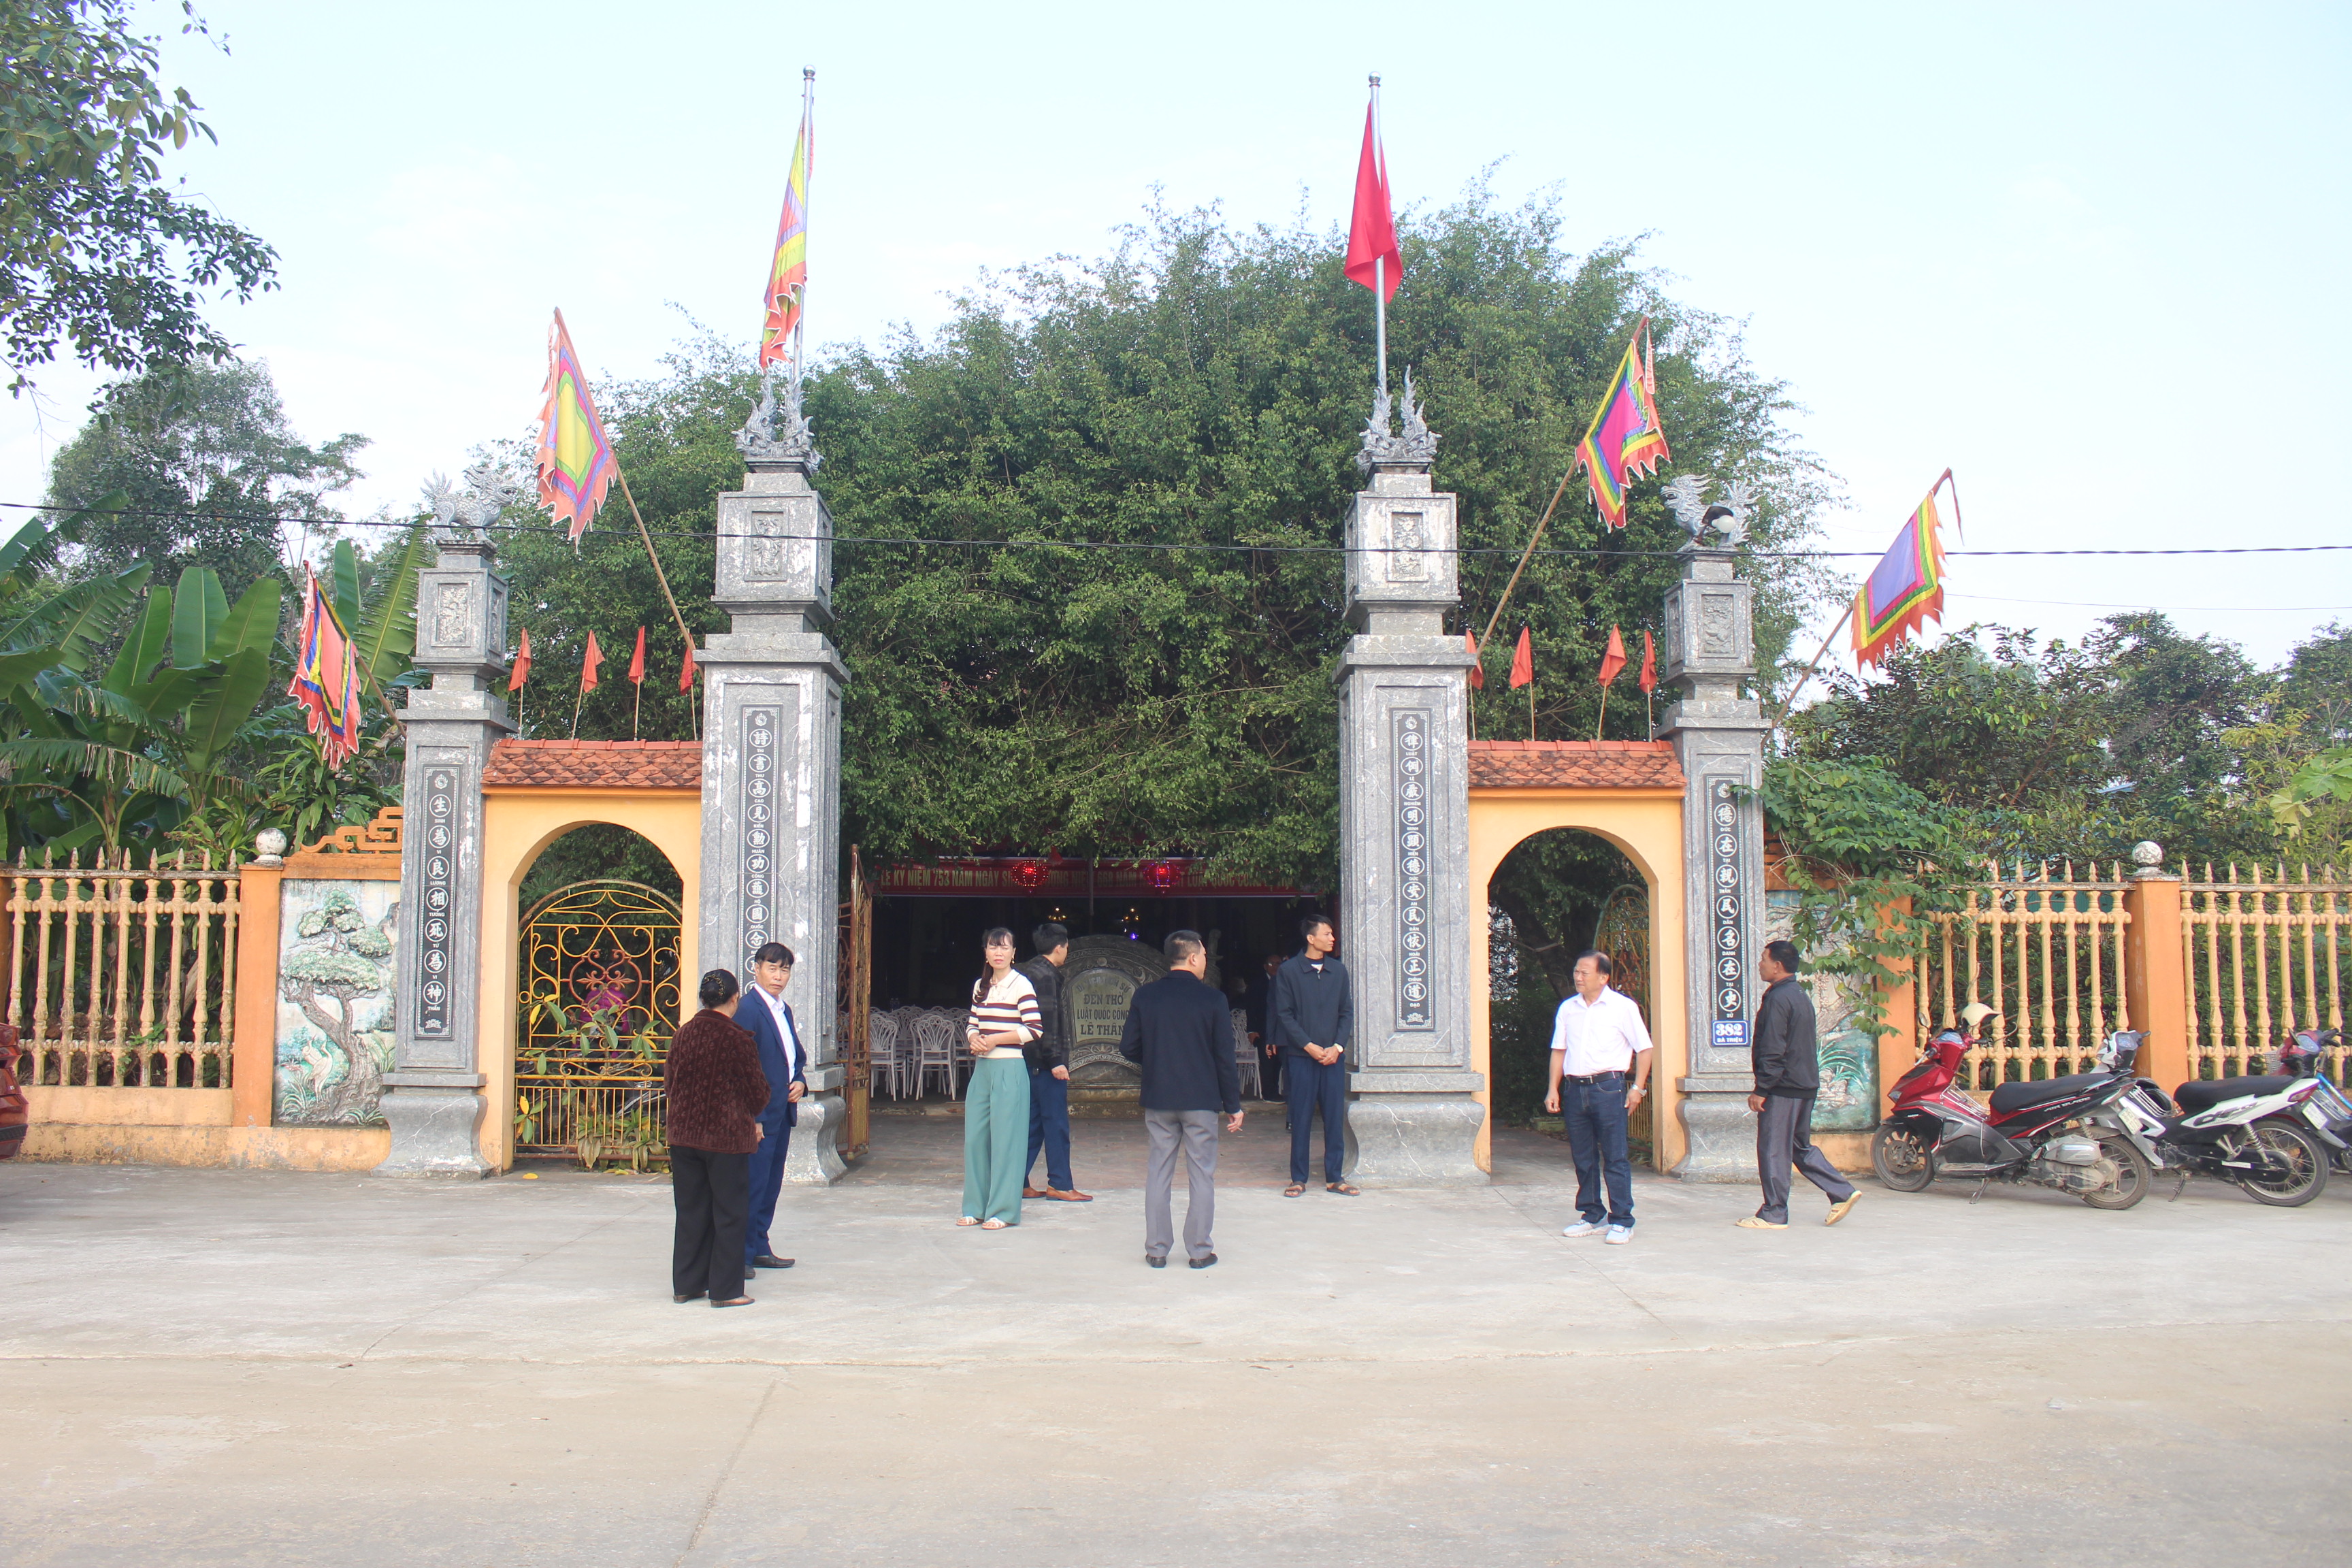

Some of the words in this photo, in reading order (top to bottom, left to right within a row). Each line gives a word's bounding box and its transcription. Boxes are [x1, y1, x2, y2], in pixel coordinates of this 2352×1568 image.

[975, 867, 999, 887] NGÀY
[1083, 990, 1103, 1004] ĐỀN
[1106, 992, 1124, 1005] THỜ
[1077, 1007, 1093, 1022] LUẬT
[1094, 1007, 1111, 1020] QUỐC
[1112, 1007, 1130, 1020] CÔNG
[1081, 1022, 1094, 1035] LÊ
[1716, 1023, 1743, 1036] 382
